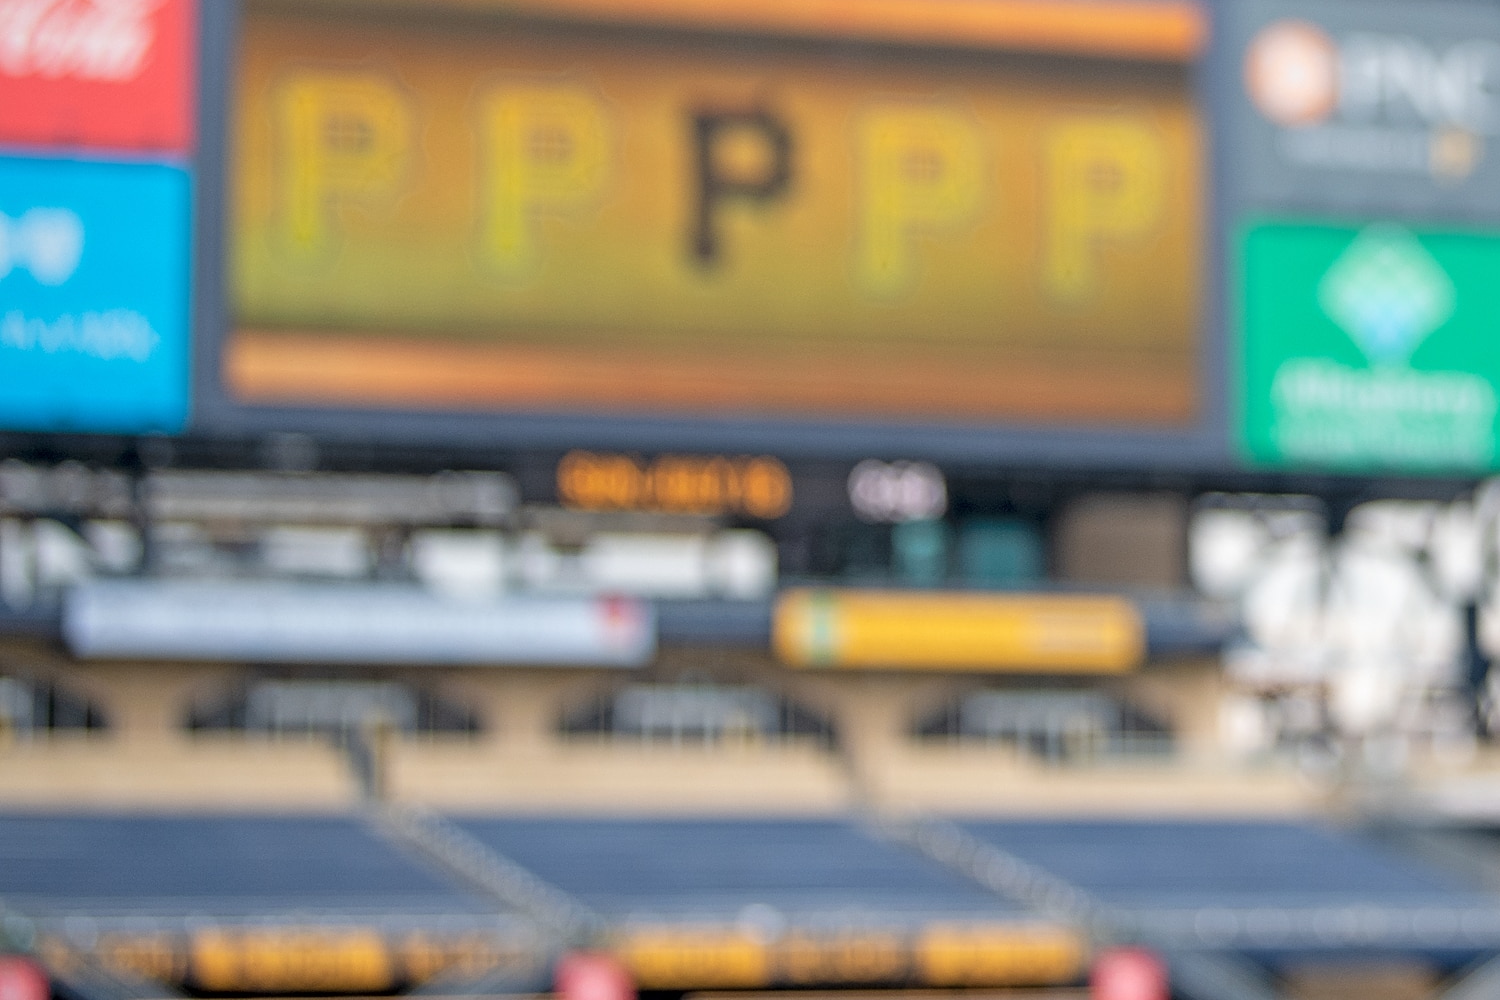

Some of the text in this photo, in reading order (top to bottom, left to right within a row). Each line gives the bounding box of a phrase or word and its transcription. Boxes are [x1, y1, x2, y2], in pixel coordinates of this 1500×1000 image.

[272, 70, 408, 255] P
[475, 80, 605, 262] P
[680, 100, 796, 275] P
[856, 104, 985, 282] P
[1045, 118, 1165, 292] P
